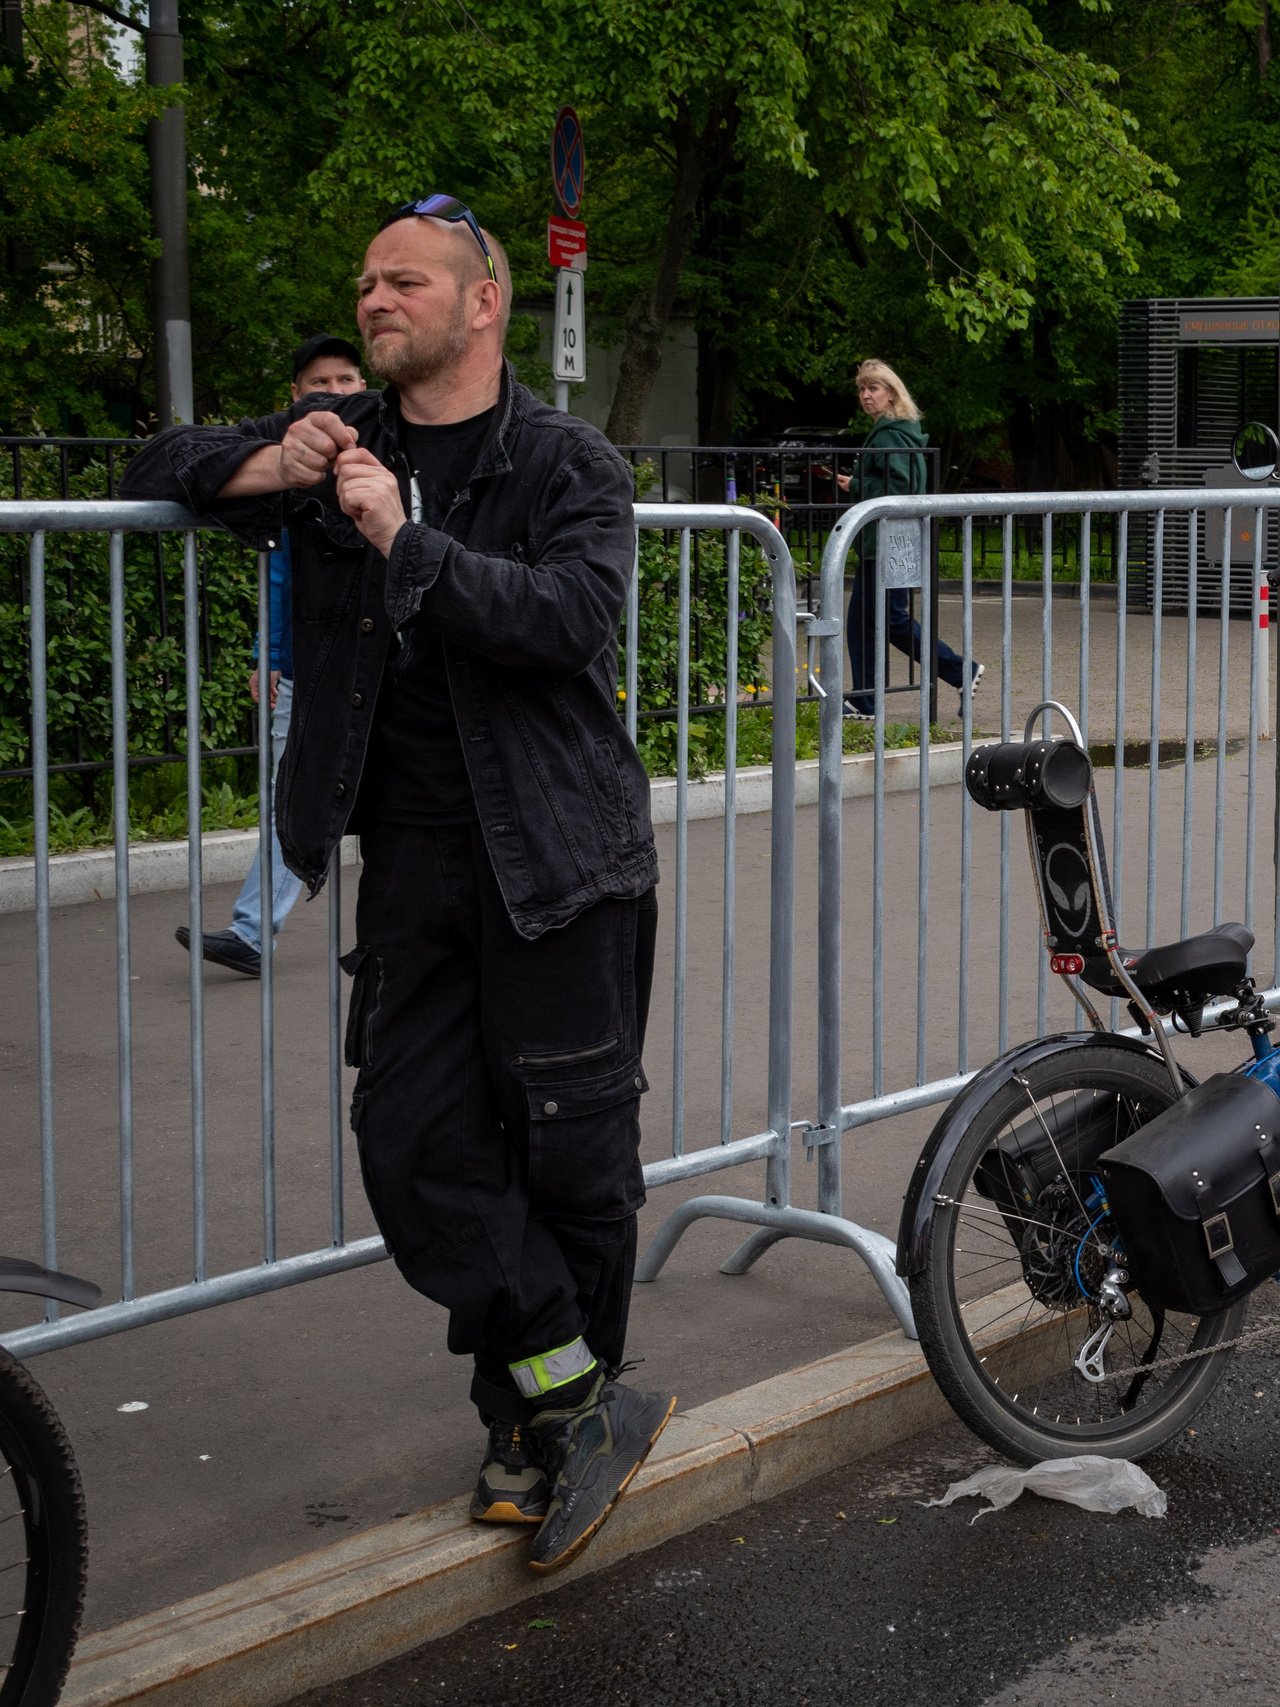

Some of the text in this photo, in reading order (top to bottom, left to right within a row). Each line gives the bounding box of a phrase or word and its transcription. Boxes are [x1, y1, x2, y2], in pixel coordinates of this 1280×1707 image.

[1184, 319, 1280, 332] СМЕШАННЫЕ ОТХО
[563, 327, 576, 349] 10
[1135, 1067, 1177, 1096] SCHWALB
